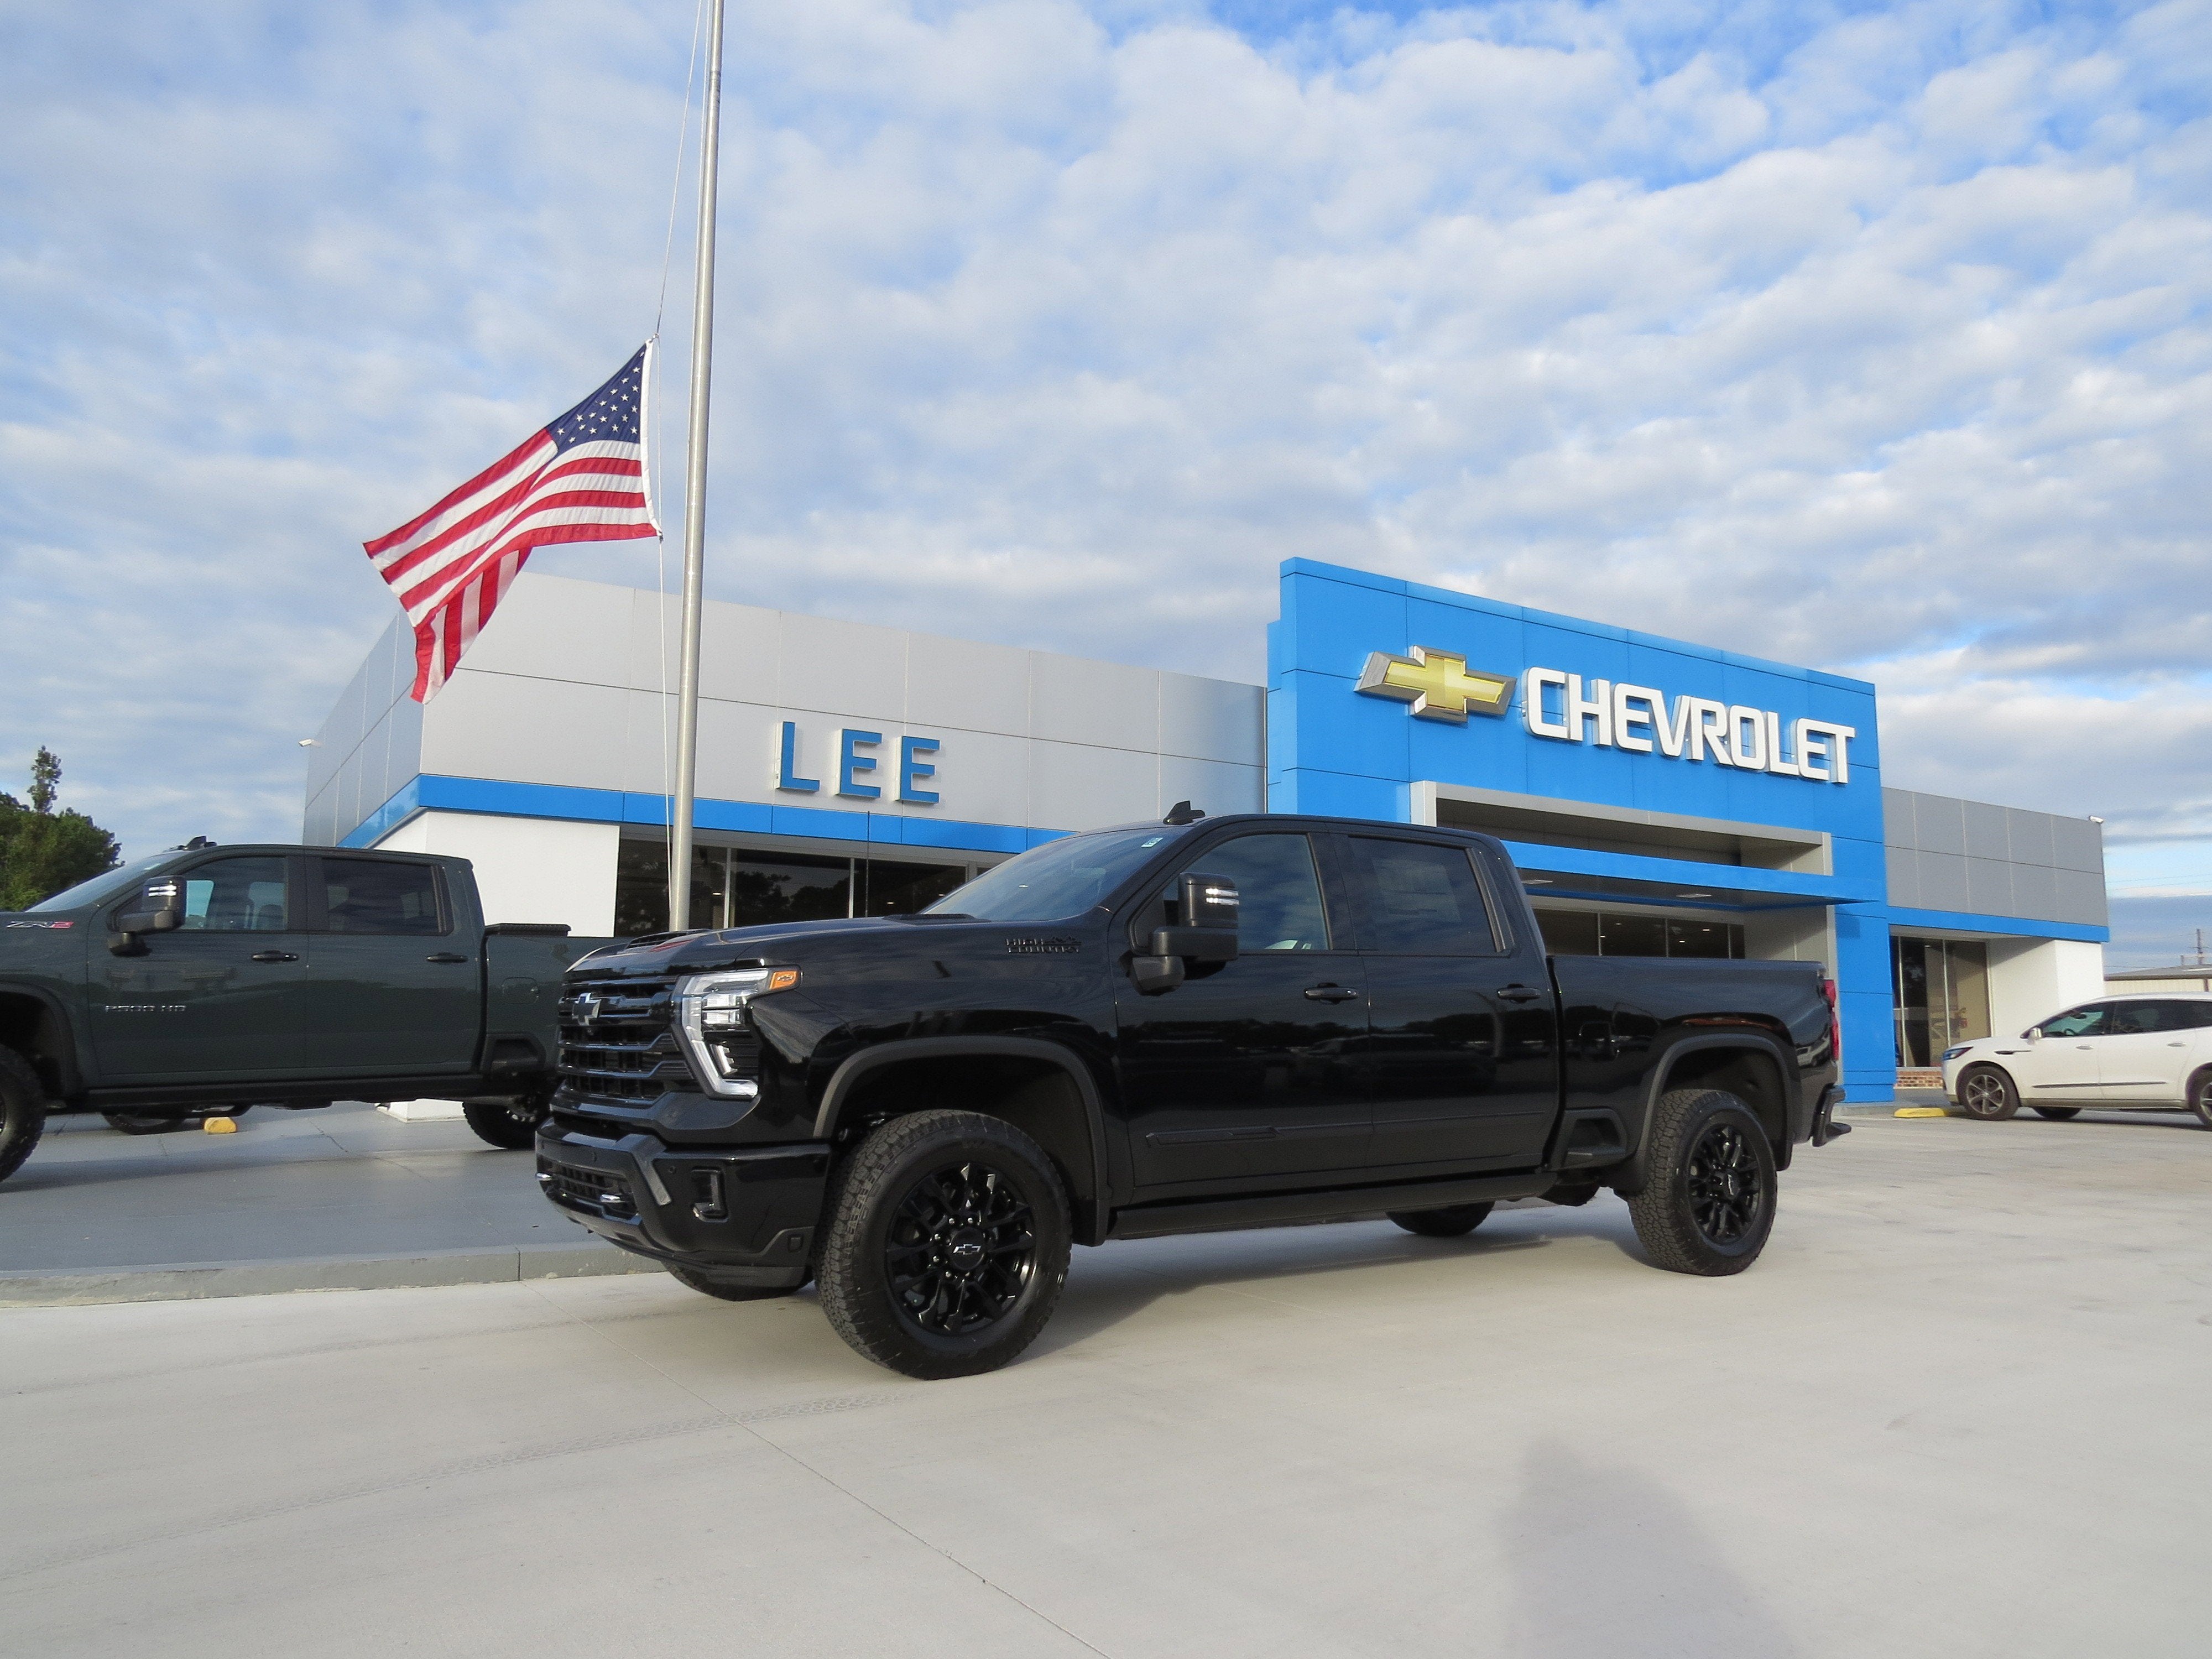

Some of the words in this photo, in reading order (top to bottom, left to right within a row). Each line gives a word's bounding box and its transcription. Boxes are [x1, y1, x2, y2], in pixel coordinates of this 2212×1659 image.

[776, 721, 941, 804] LEE
[1522, 667, 1855, 784] CHEVROLET
[6, 920, 74, 928] ZR2
